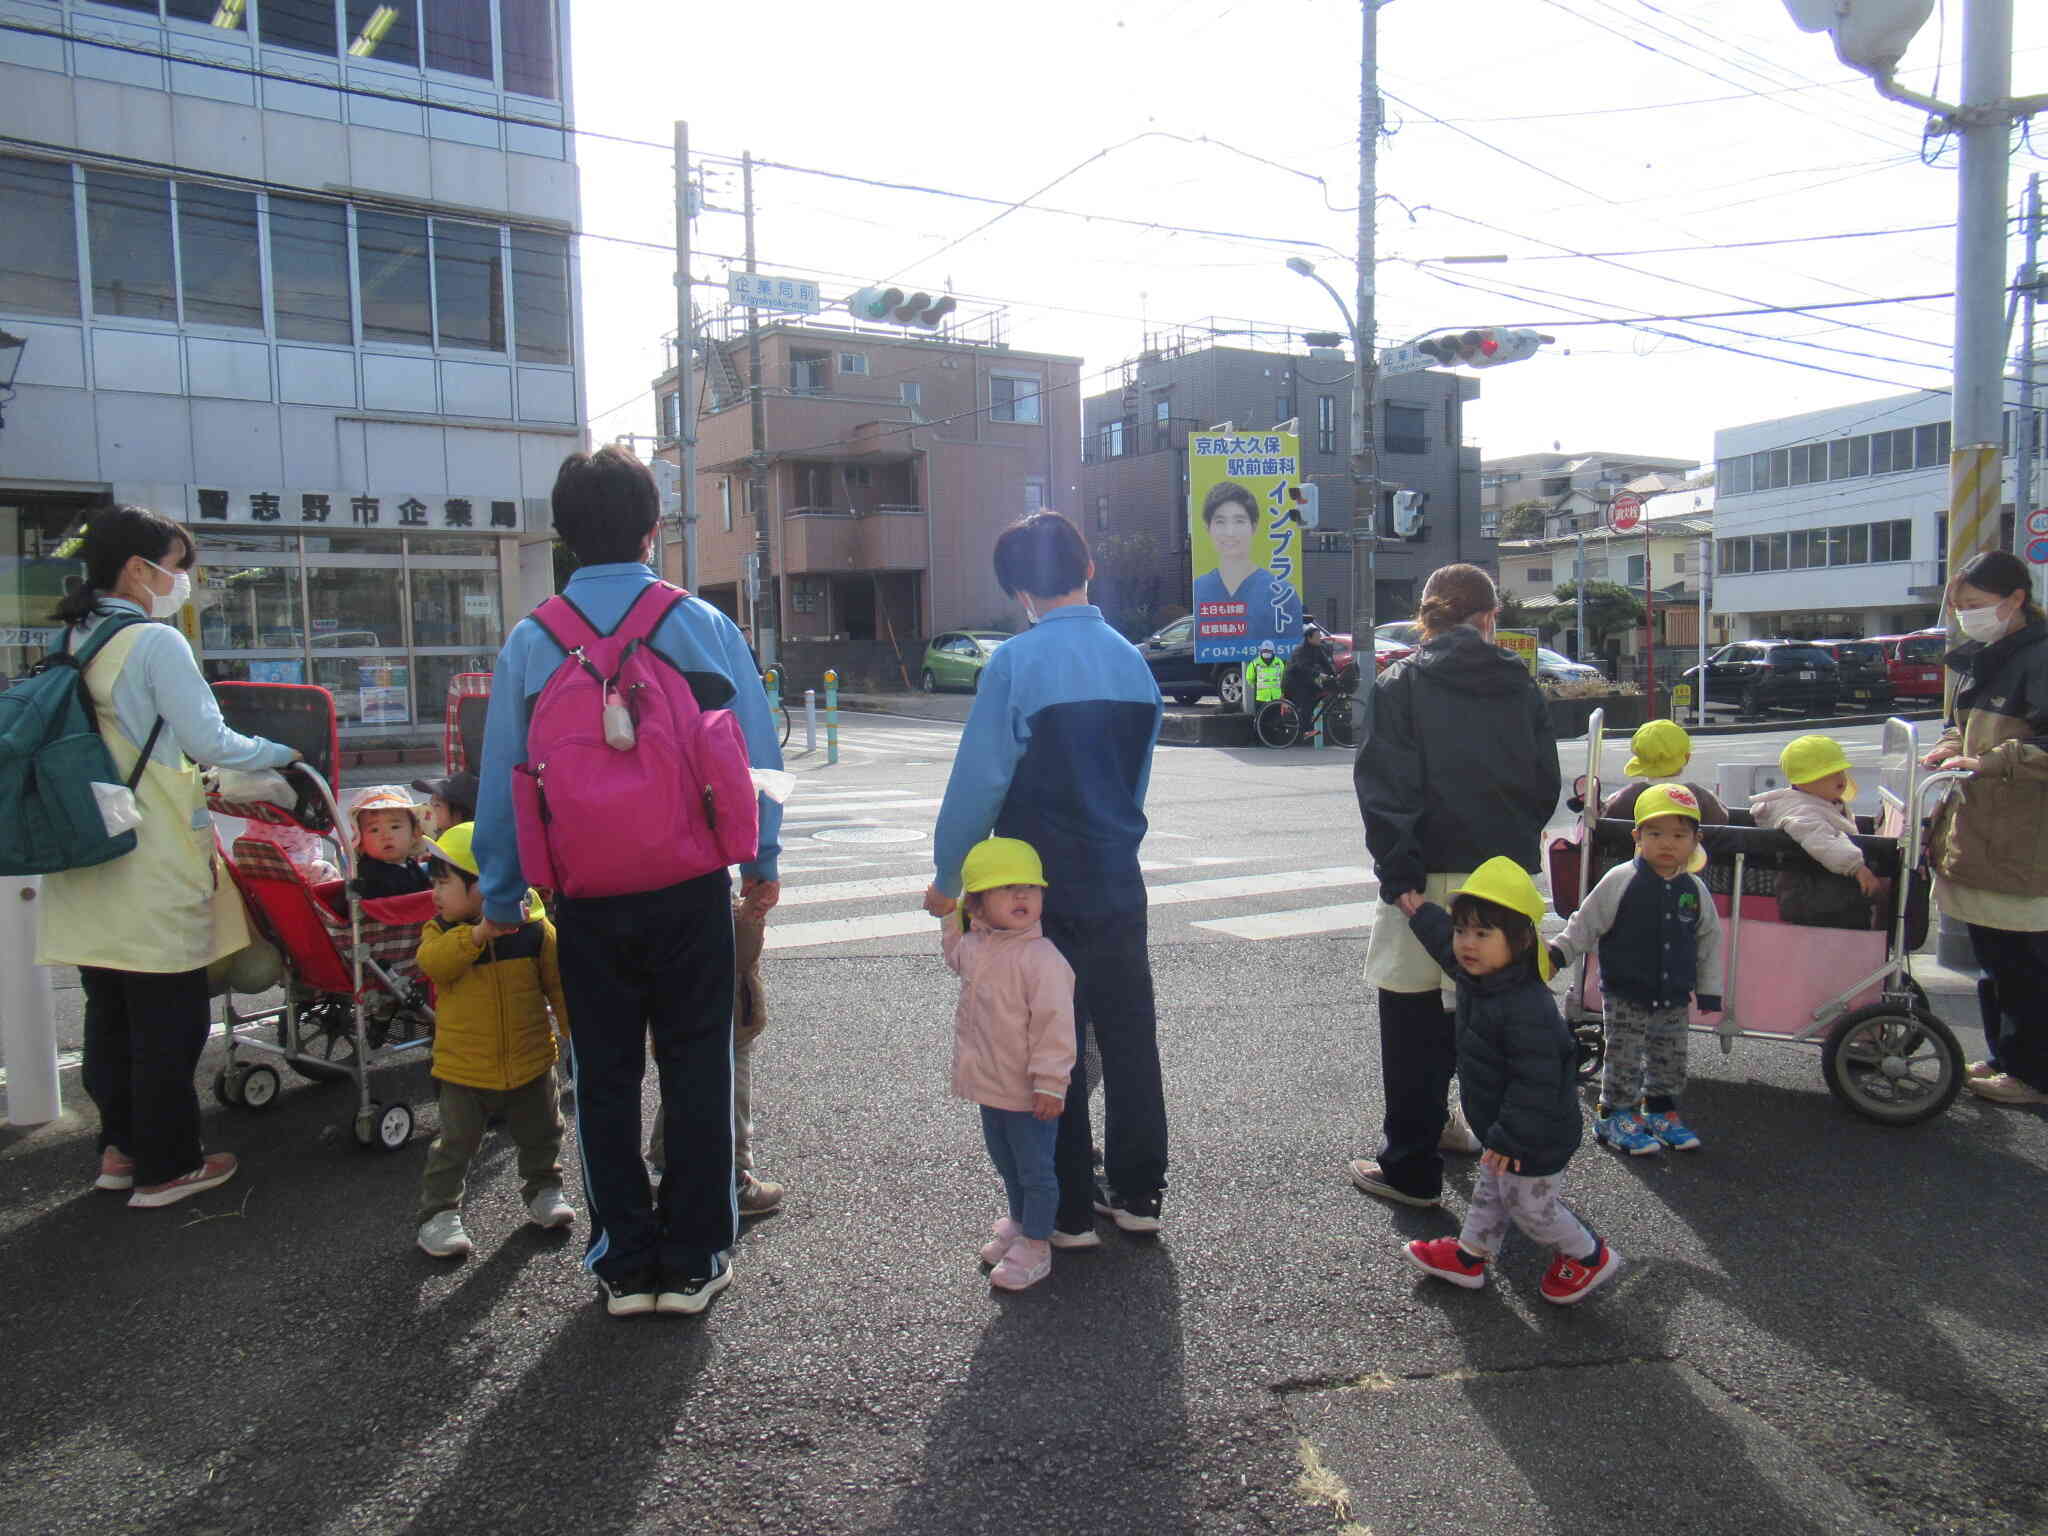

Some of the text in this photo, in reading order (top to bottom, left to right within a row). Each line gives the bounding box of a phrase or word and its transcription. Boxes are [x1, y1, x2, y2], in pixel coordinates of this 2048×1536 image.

[1195, 437, 1281, 455] 京成大久保
[1227, 458, 1295, 476] 駅前歯科
[198, 489, 517, 527] 習志野市企業局
[1267, 480, 1295, 633] インプラント
